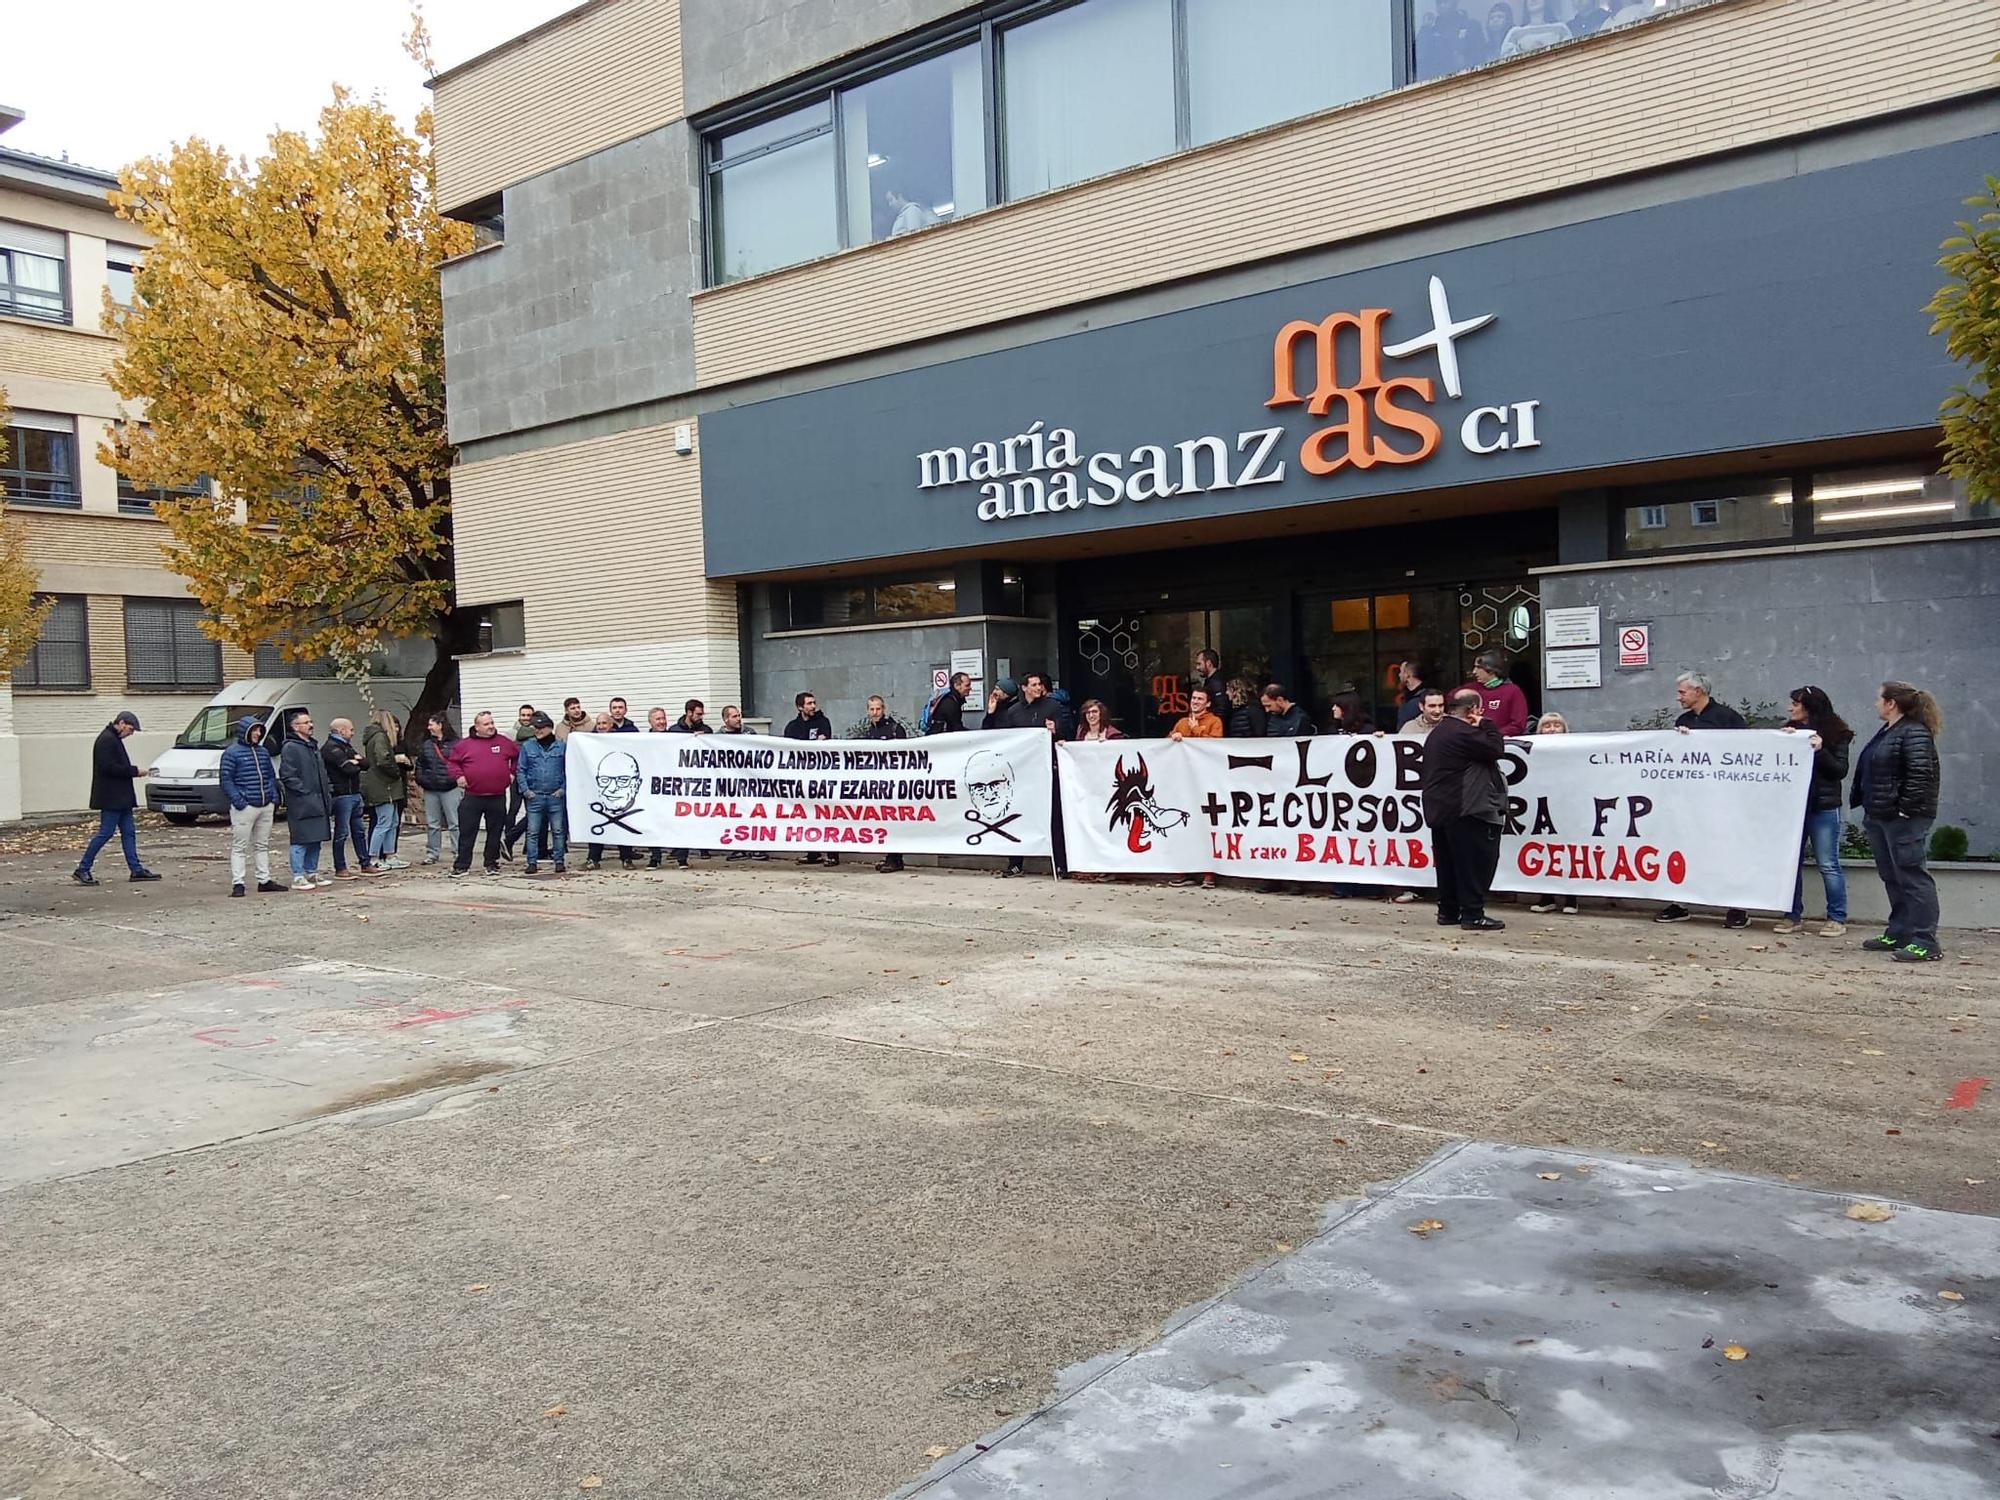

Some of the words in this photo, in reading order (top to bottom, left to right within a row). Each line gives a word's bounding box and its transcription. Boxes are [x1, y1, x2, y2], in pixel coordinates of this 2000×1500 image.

[916, 420, 1085, 489] maría
[976, 471, 1087, 522] ana
[1087, 426, 1286, 506] sanz
[678, 749, 774, 769] NAFARROAKO
[777, 750, 840, 770] LANBIDE
[843, 750, 933, 773] HEZIKETAN,
[1681, 751, 1712, 766] ANA
[1720, 752, 1764, 767] SANZ
[651, 776, 711, 797] BERTZE
[715, 778, 805, 798] MURRIZKETA
[808, 780, 837, 799] BAT
[840, 780, 894, 799] EZARRI
[898, 779, 957, 800] DIGUTE
[675, 801, 742, 818] DUAL
[750, 803, 767, 818] A
[775, 804, 807, 819] LA
[815, 804, 936, 821] NAVARRA
[1592, 796, 1653, 838] FP
[720, 825, 777, 844] ¿SIN
[786, 826, 888, 844] HORAS?
